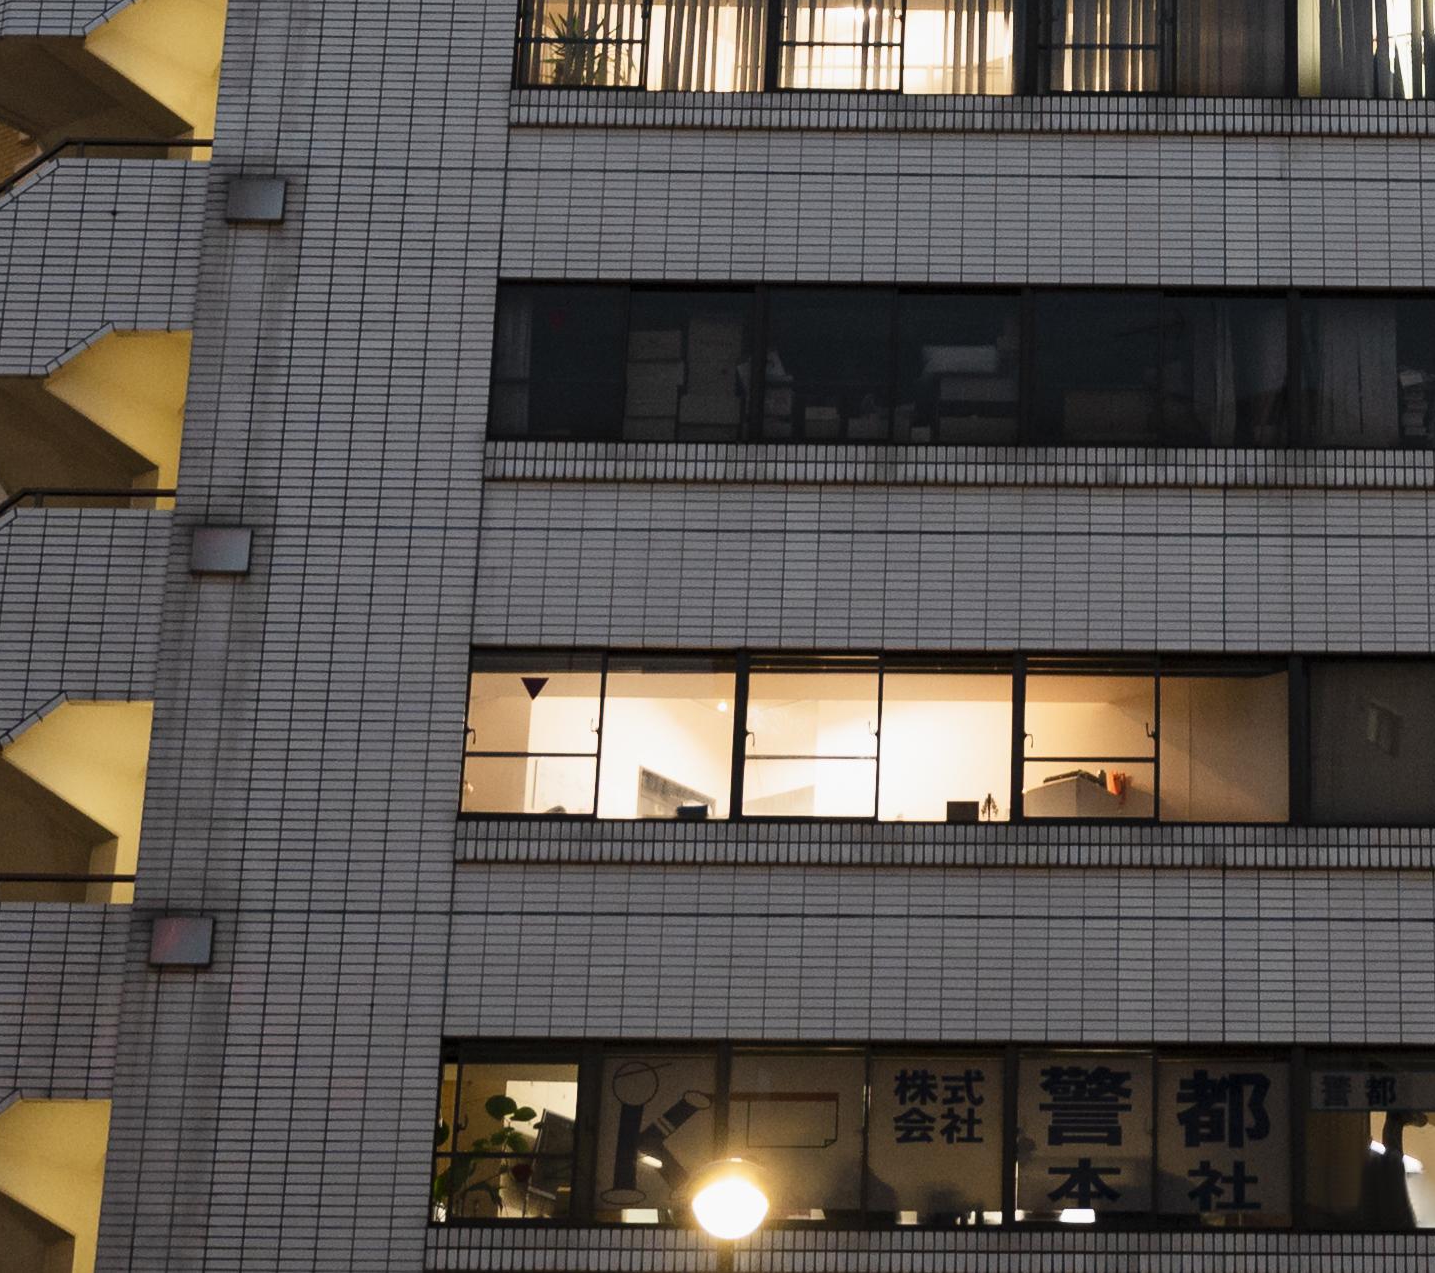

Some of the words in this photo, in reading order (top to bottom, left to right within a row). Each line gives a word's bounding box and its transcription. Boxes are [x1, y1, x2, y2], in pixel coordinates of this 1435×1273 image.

[894, 1069, 985, 1106] 株式
[1039, 1066, 1271, 1147] 警都
[893, 1107, 984, 1144] 会社
[1047, 1158, 1261, 1210] 本社
